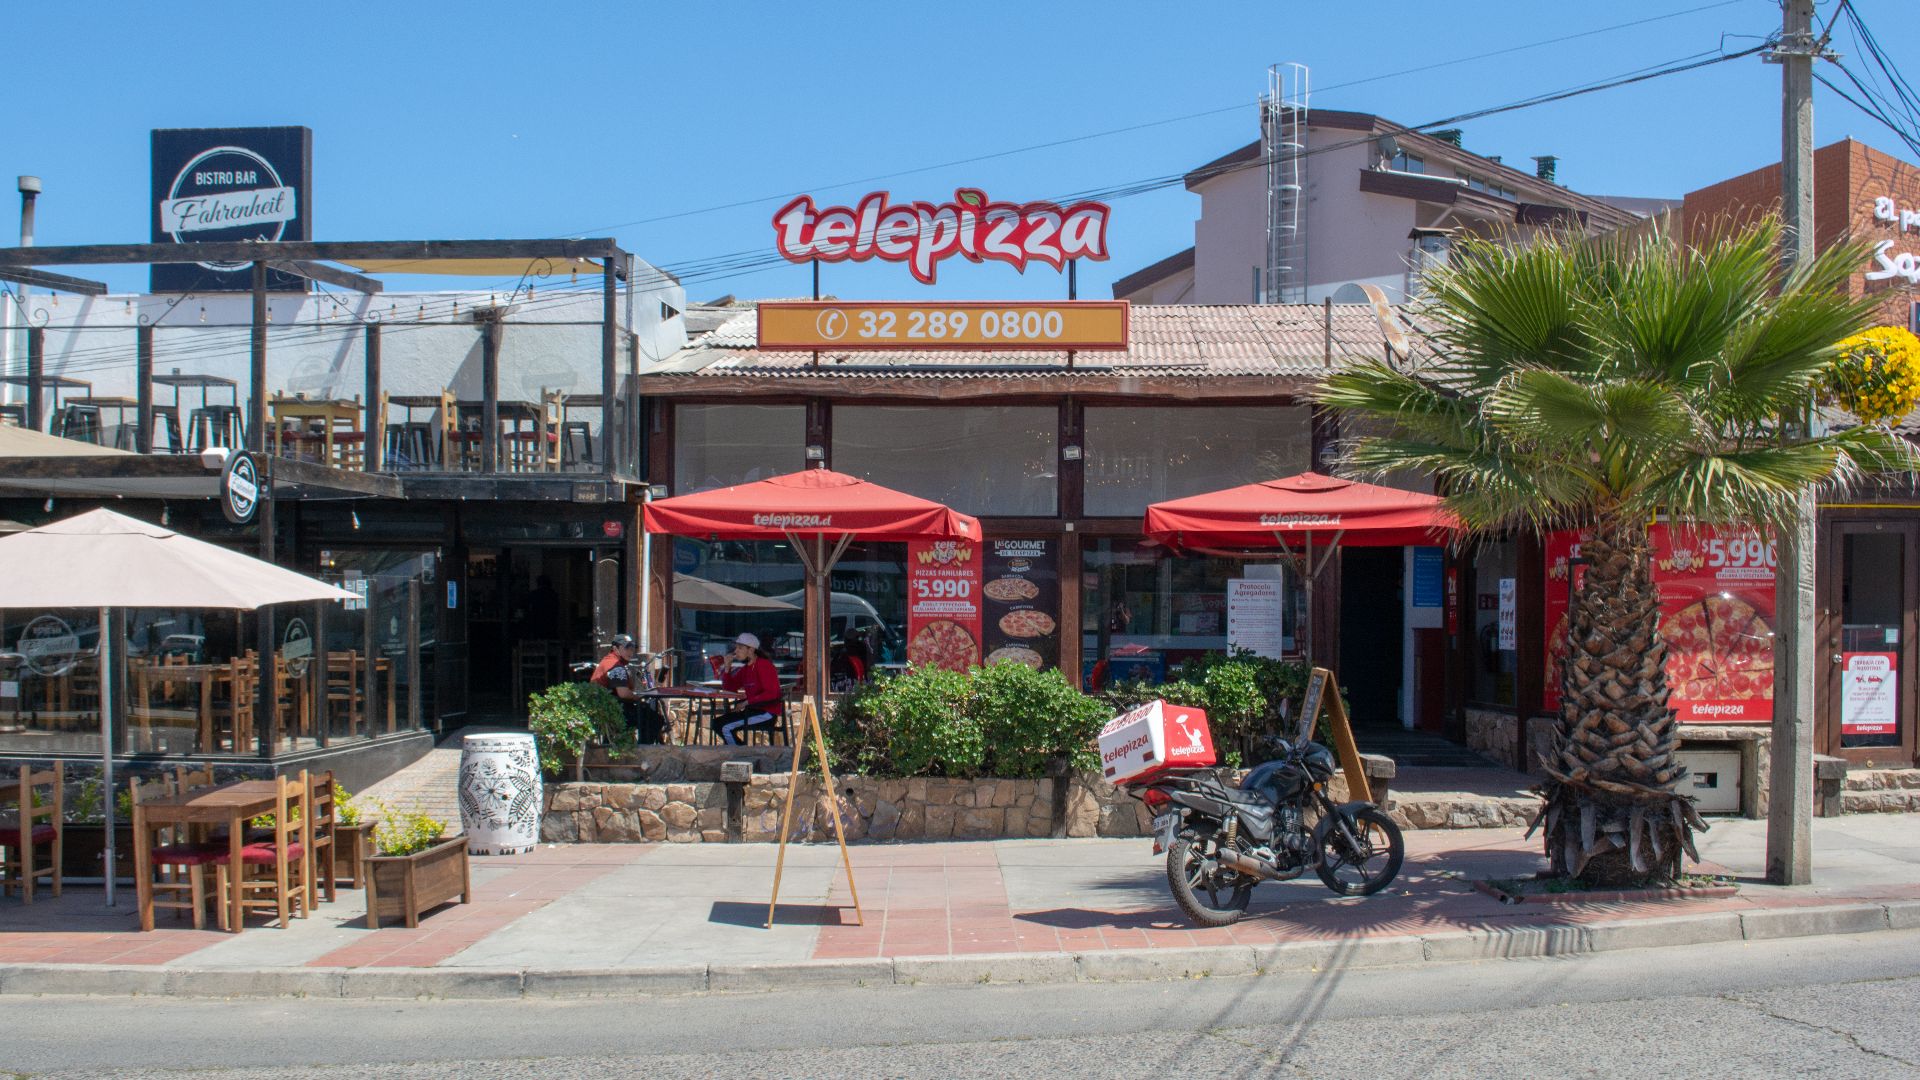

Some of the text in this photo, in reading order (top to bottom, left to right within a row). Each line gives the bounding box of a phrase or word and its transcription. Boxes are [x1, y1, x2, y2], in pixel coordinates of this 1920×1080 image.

[195, 171, 257, 185] BISTRO BAR
[171, 191, 285, 230] Fahrenheit
[777, 194, 1106, 279] telepizza
[858, 311, 1064, 338] 32 289 0800
[753, 512, 832, 530] telepizza.cl
[1260, 512, 1341, 529] telepizza.cl
[934, 541, 957, 549] tele
[1004, 540, 1046, 549] GOURMET
[912, 579, 970, 598] $5.990
[1692, 703, 1744, 718] telepizza
[1103, 733, 1149, 764] telepizza
[1171, 745, 1205, 757] telepizza
